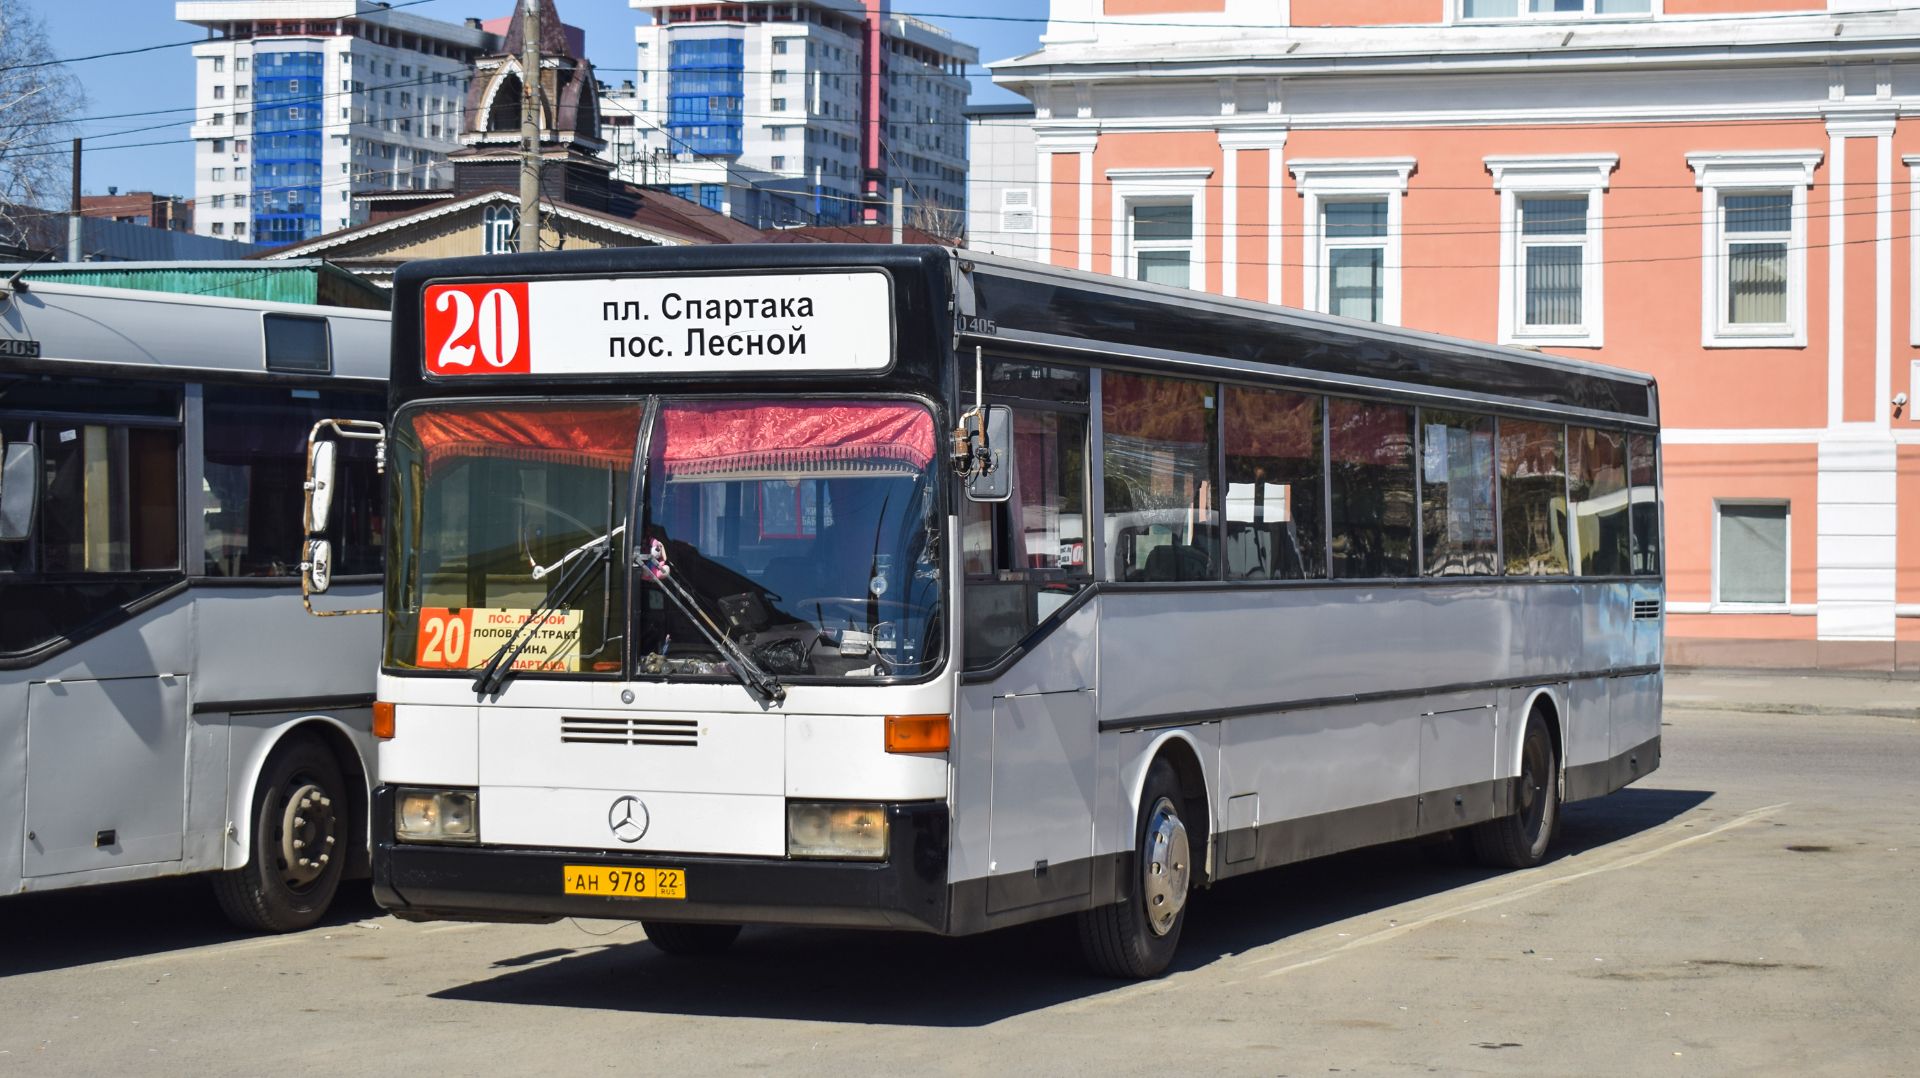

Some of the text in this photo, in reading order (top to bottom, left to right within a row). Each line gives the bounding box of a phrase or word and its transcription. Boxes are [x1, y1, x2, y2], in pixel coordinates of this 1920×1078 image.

[603, 292, 814, 326] пл. Спартака
[436, 288, 520, 368] 20
[969, 318, 996, 335] 405
[609, 325, 806, 358] пос. Лесной
[488, 614, 514, 624] ПОС.
[422, 617, 465, 663] 20
[502, 644, 548, 655] ЕИНА
[508, 659, 566, 670] ПАРТАКА
[575, 871, 678, 893] АН 978 22
